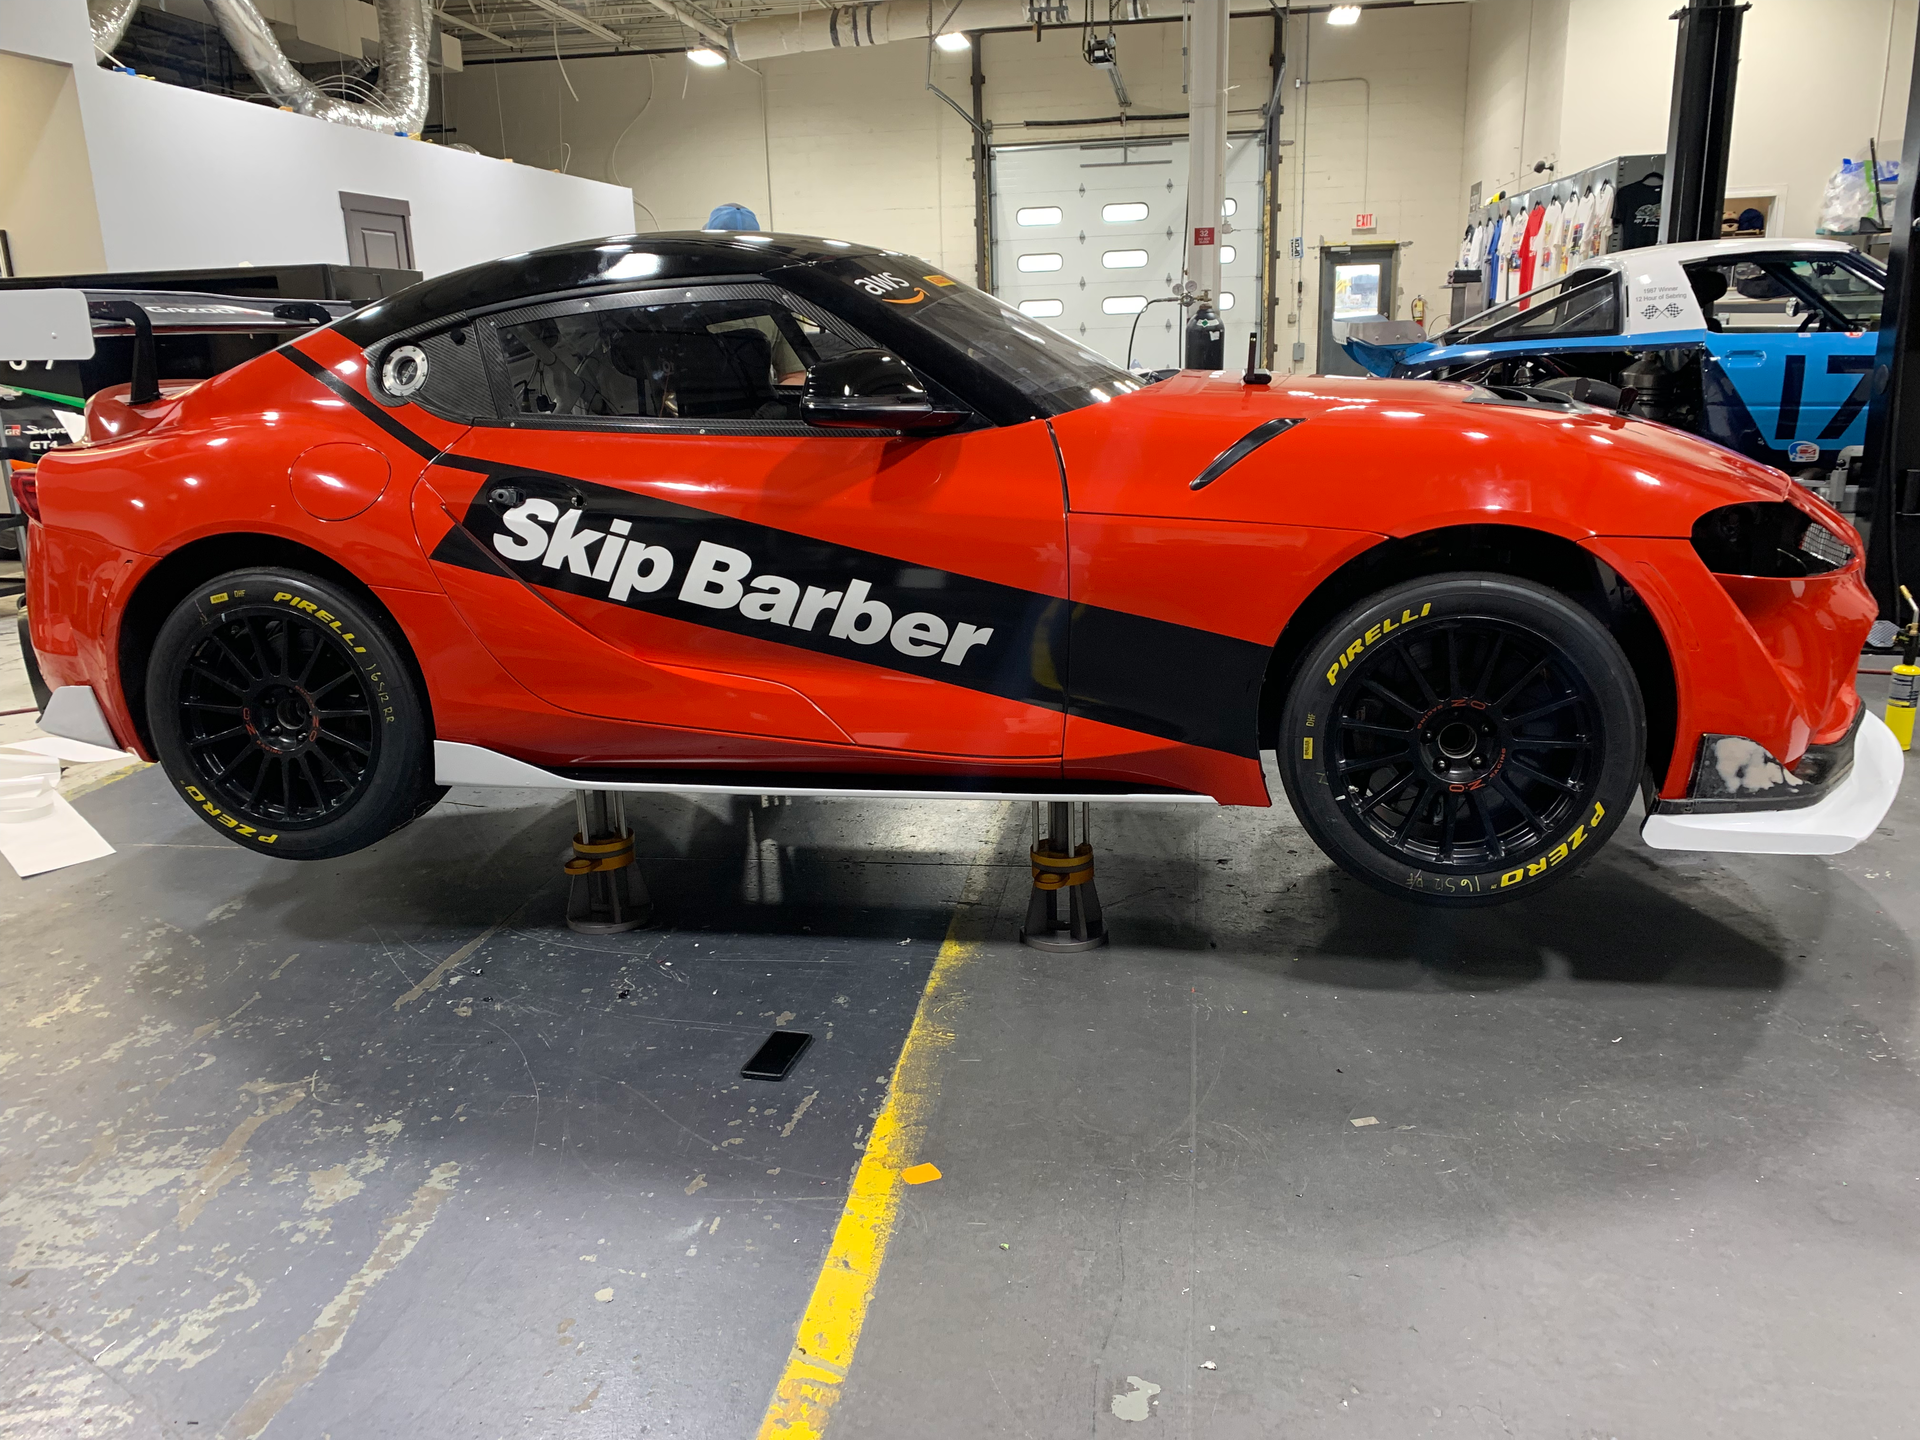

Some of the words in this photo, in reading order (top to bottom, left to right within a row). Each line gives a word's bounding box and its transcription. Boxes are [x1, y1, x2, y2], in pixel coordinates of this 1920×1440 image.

[1199, 229, 1209, 237] 32
[1356, 213, 1373, 227] EXIT
[854, 272, 910, 295] aws
[1774, 354, 1876, 440] 17
[29, 440, 59, 450] GT4
[493, 498, 674, 602] Skip
[678, 541, 995, 667] Barber
[273, 591, 367, 654] PIRELLI
[1326, 602, 1432, 686] PIRELLI
